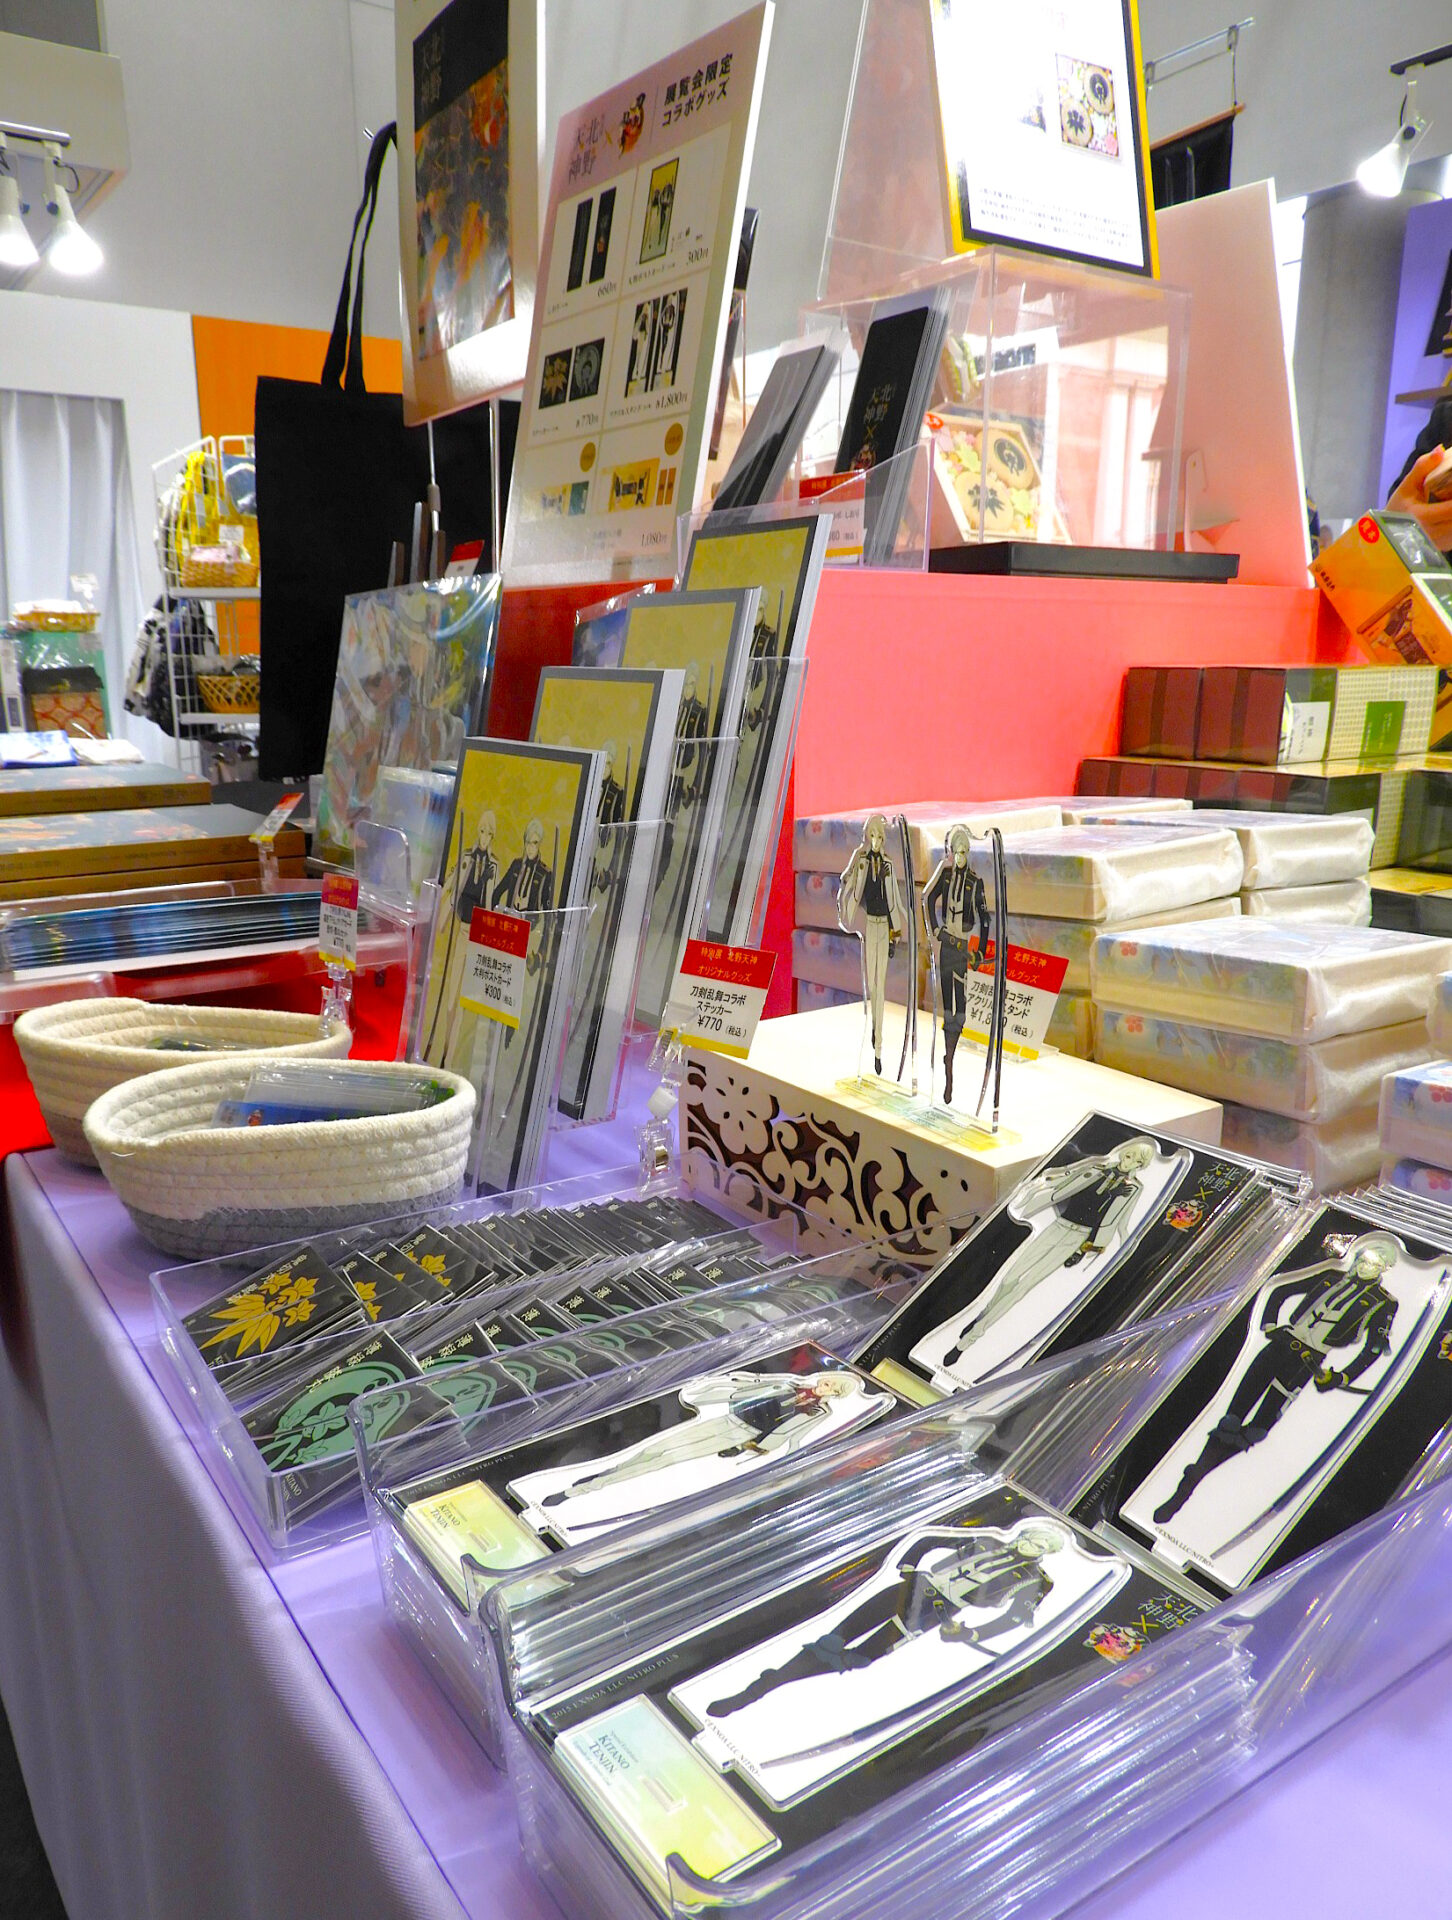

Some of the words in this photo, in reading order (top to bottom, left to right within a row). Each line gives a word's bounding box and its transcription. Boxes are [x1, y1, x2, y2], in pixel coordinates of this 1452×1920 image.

[661, 77, 731, 127] コラボグッズ
[727, 947, 759, 965] 北野天神
[1013, 951, 1048, 968] 北野天神
[473, 967, 512, 987] 大判ポストカード
[697, 964, 753, 983] オリジナルグッズ
[485, 983, 502, 1001] ¥300
[689, 985, 748, 1006] 刀剣乱舞コラボ
[696, 1000, 733, 1016] ステッカー
[697, 1014, 723, 1032] ¥770
[439, 1503, 461, 1527] KITANO
[588, 1741, 615, 1774] TENJIN
[598, 1733, 630, 1769] KITANO
